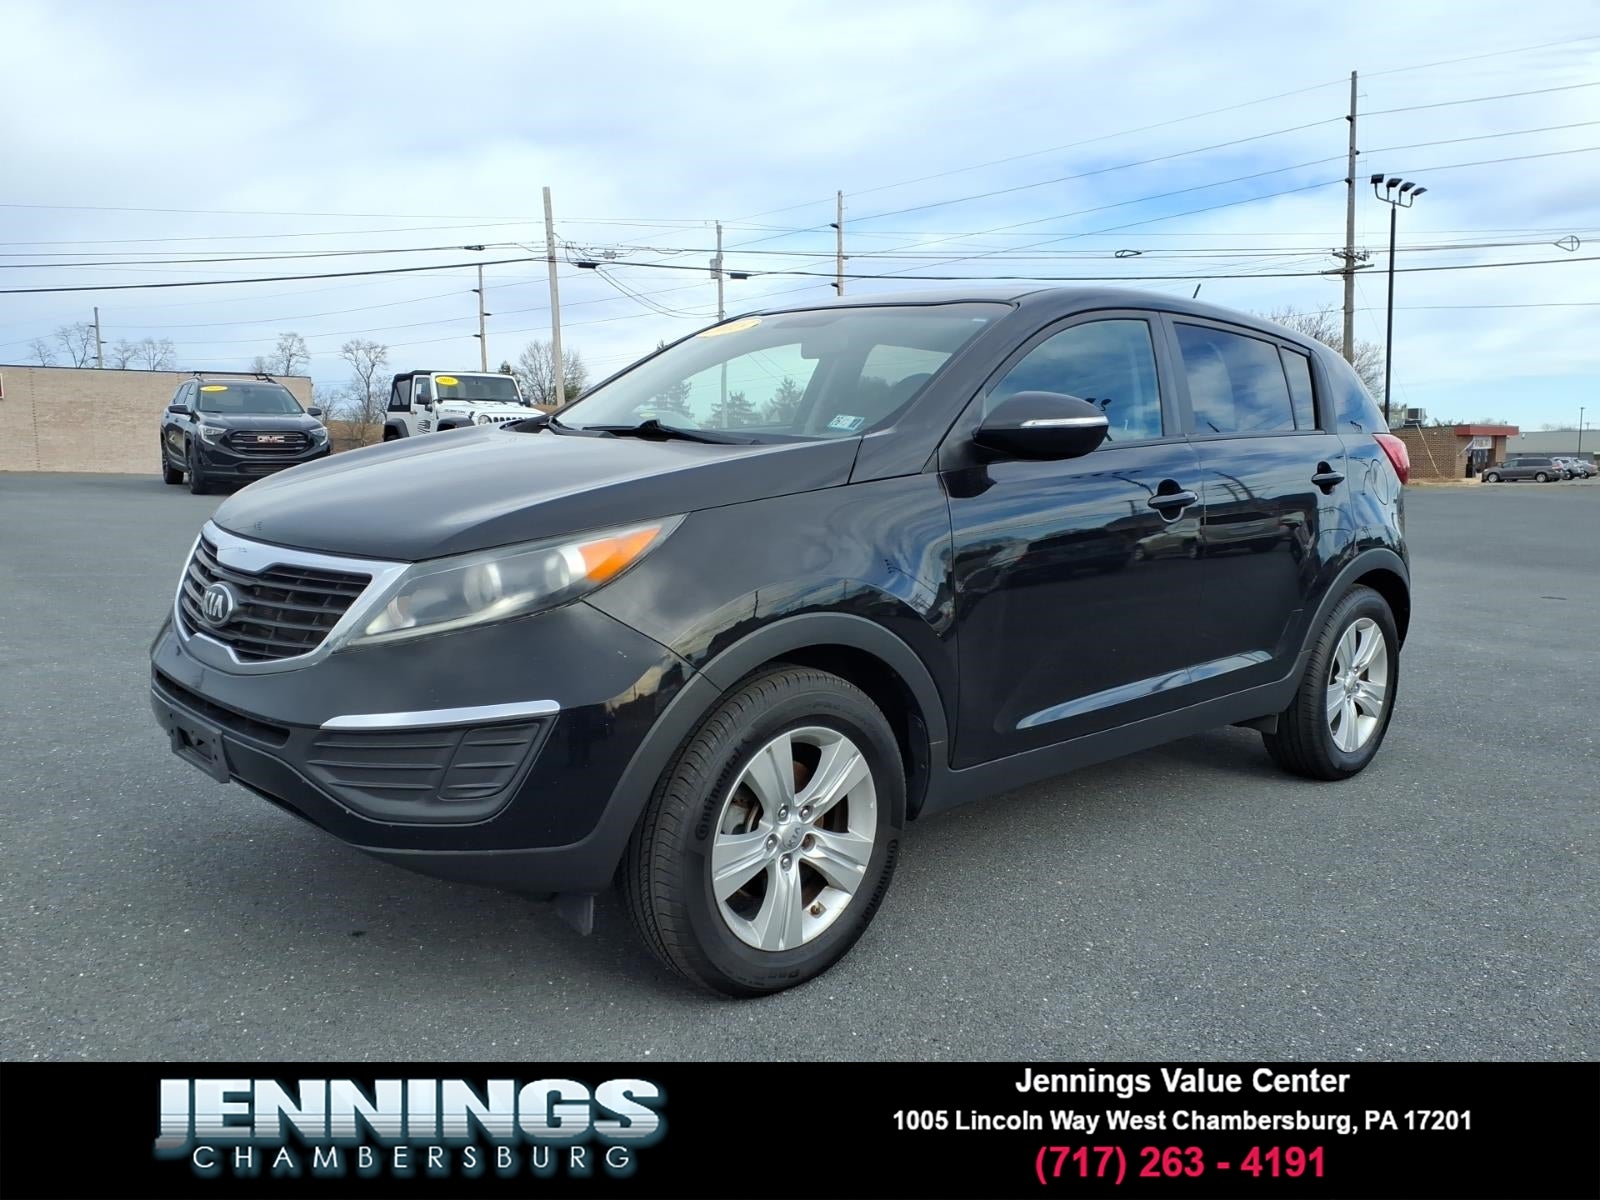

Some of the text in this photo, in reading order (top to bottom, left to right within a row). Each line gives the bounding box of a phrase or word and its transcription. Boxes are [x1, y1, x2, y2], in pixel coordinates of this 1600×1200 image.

[256, 434, 286, 444] GMC
[202, 590, 224, 618] KIA
[695, 747, 742, 840] Continental
